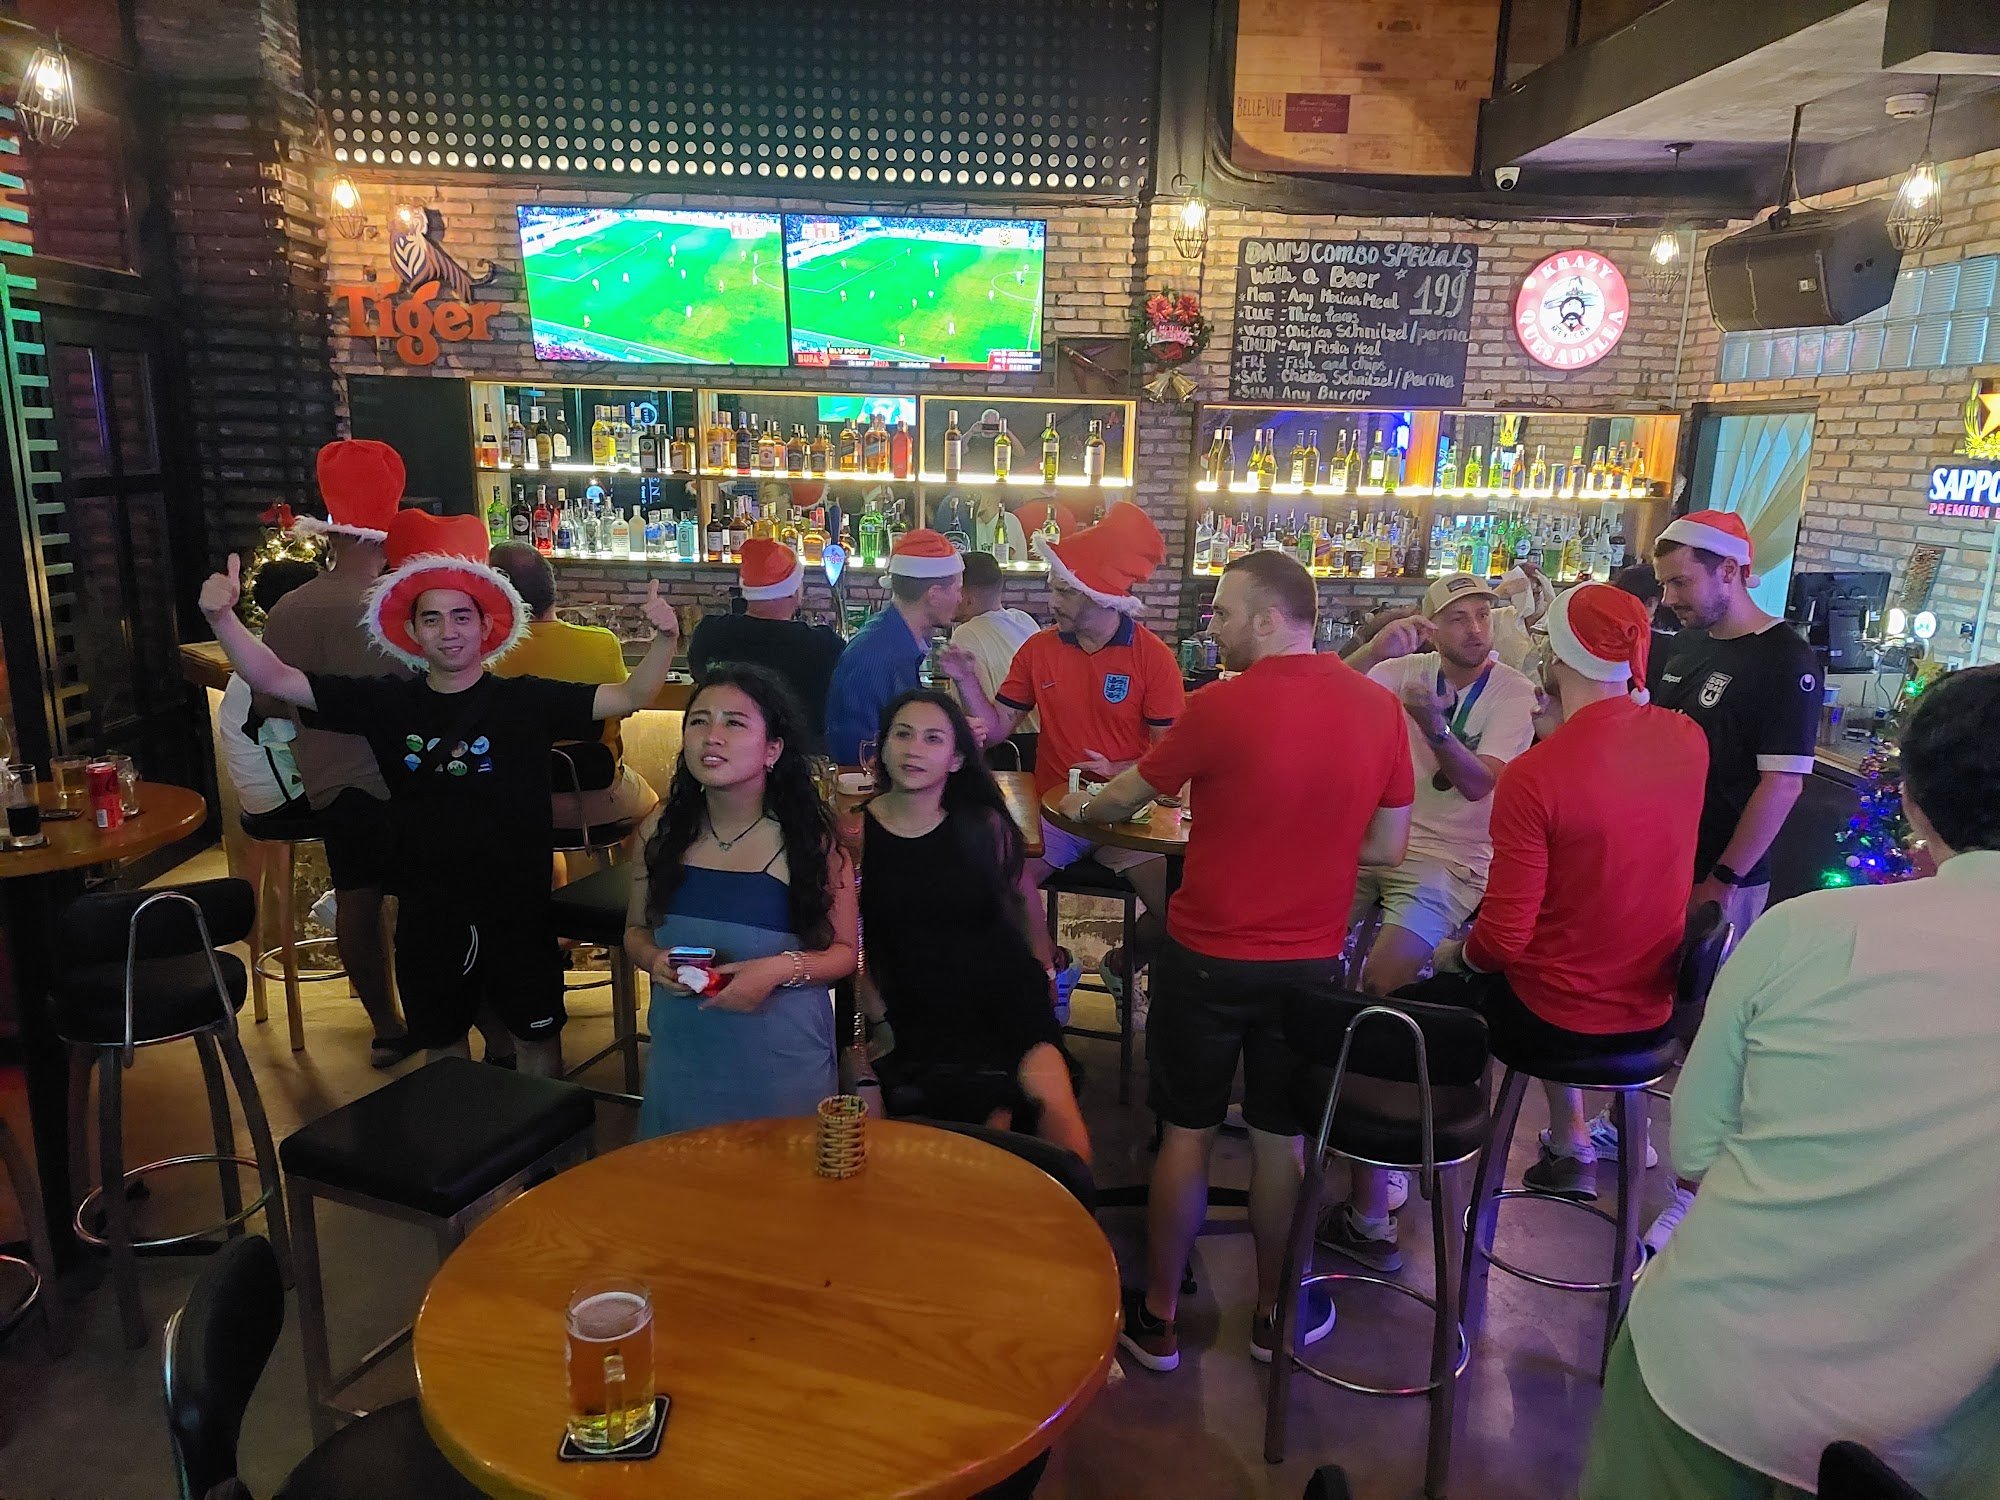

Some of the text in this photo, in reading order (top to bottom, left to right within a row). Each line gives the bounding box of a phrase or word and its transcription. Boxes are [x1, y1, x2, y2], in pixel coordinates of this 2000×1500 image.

[1237, 97, 1282, 118] BELLE-VUE
[1303, 268, 1320, 285] a
[1330, 265, 1380, 289] Beer
[1540, 255, 1614, 280] KRAZY
[1287, 288, 1314, 311] Any
[1363, 291, 1400, 310] Meal
[1409, 273, 1467, 318] 199
[333, 280, 503, 366] Tiger
[1286, 324, 1333, 339] Chicken
[1287, 339, 1312, 358] Any
[1281, 385, 1311, 402] Any
[1317, 385, 1371, 404] Burger
[1929, 503, 1990, 518] PREMIUM
